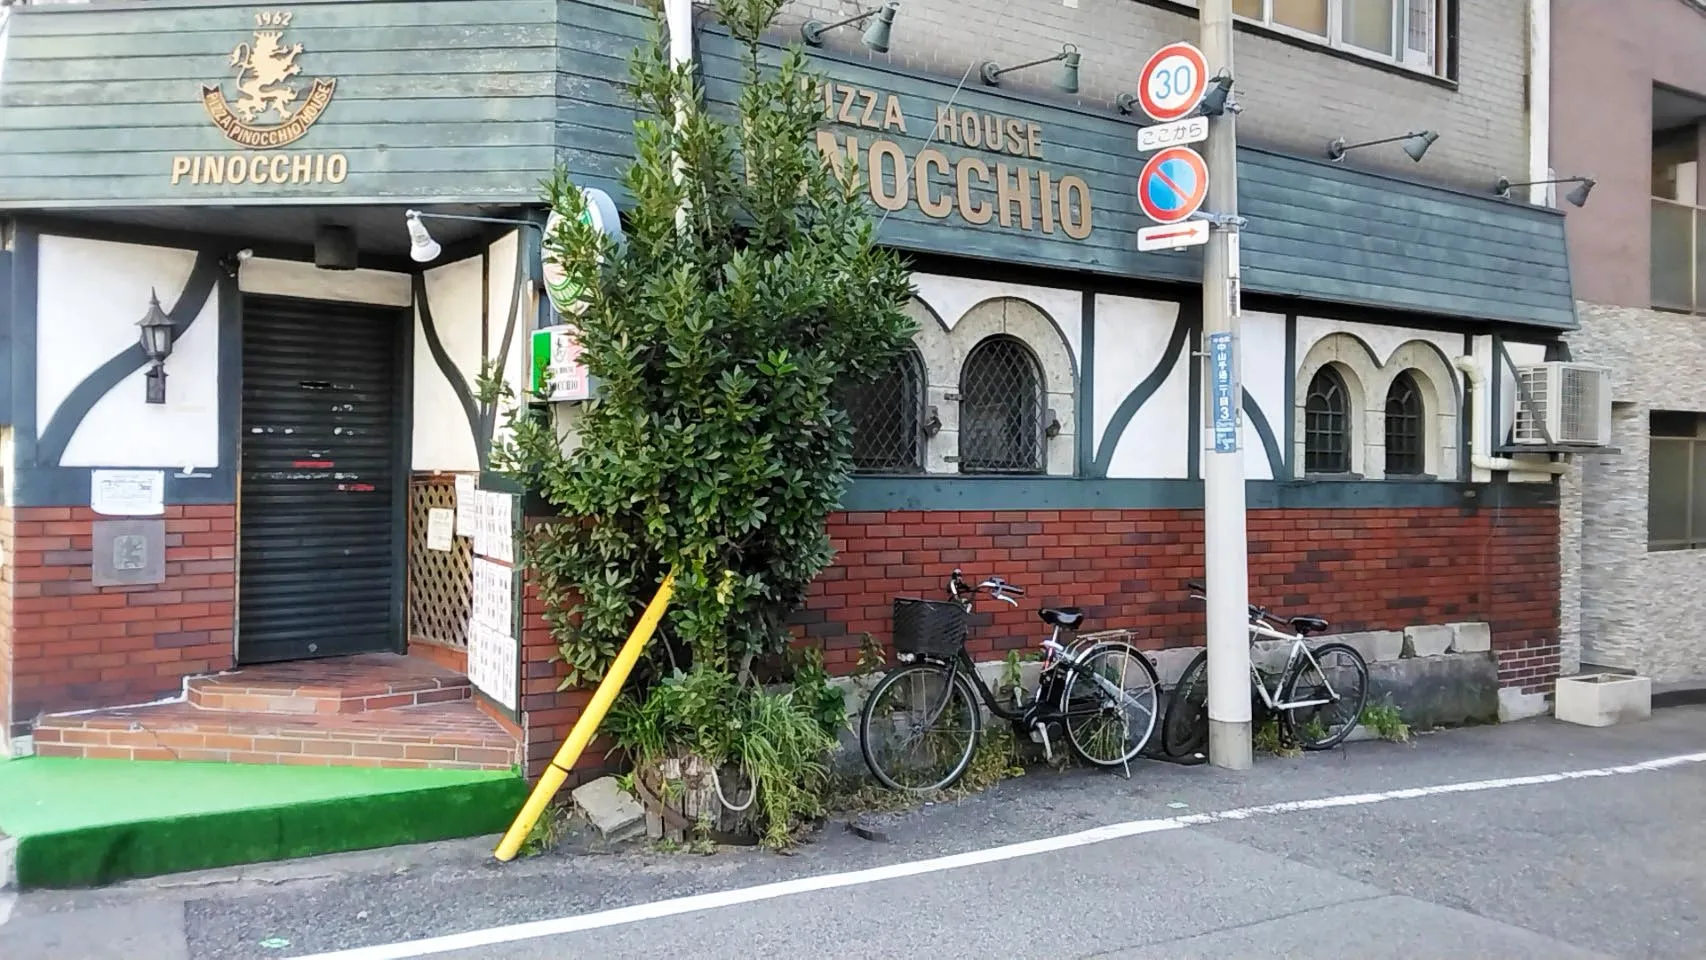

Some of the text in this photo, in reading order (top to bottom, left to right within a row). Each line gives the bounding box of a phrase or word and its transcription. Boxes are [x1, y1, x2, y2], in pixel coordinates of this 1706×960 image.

[255, 12, 293, 26] 1962
[1155, 65, 1191, 99] 30
[206, 85, 330, 145] PIZZA PINOCCHIO HOUSE
[936, 105, 1043, 159] HOUSE
[1143, 123, 1202, 145] ここから
[171, 154, 348, 185] PINOCCHIO
